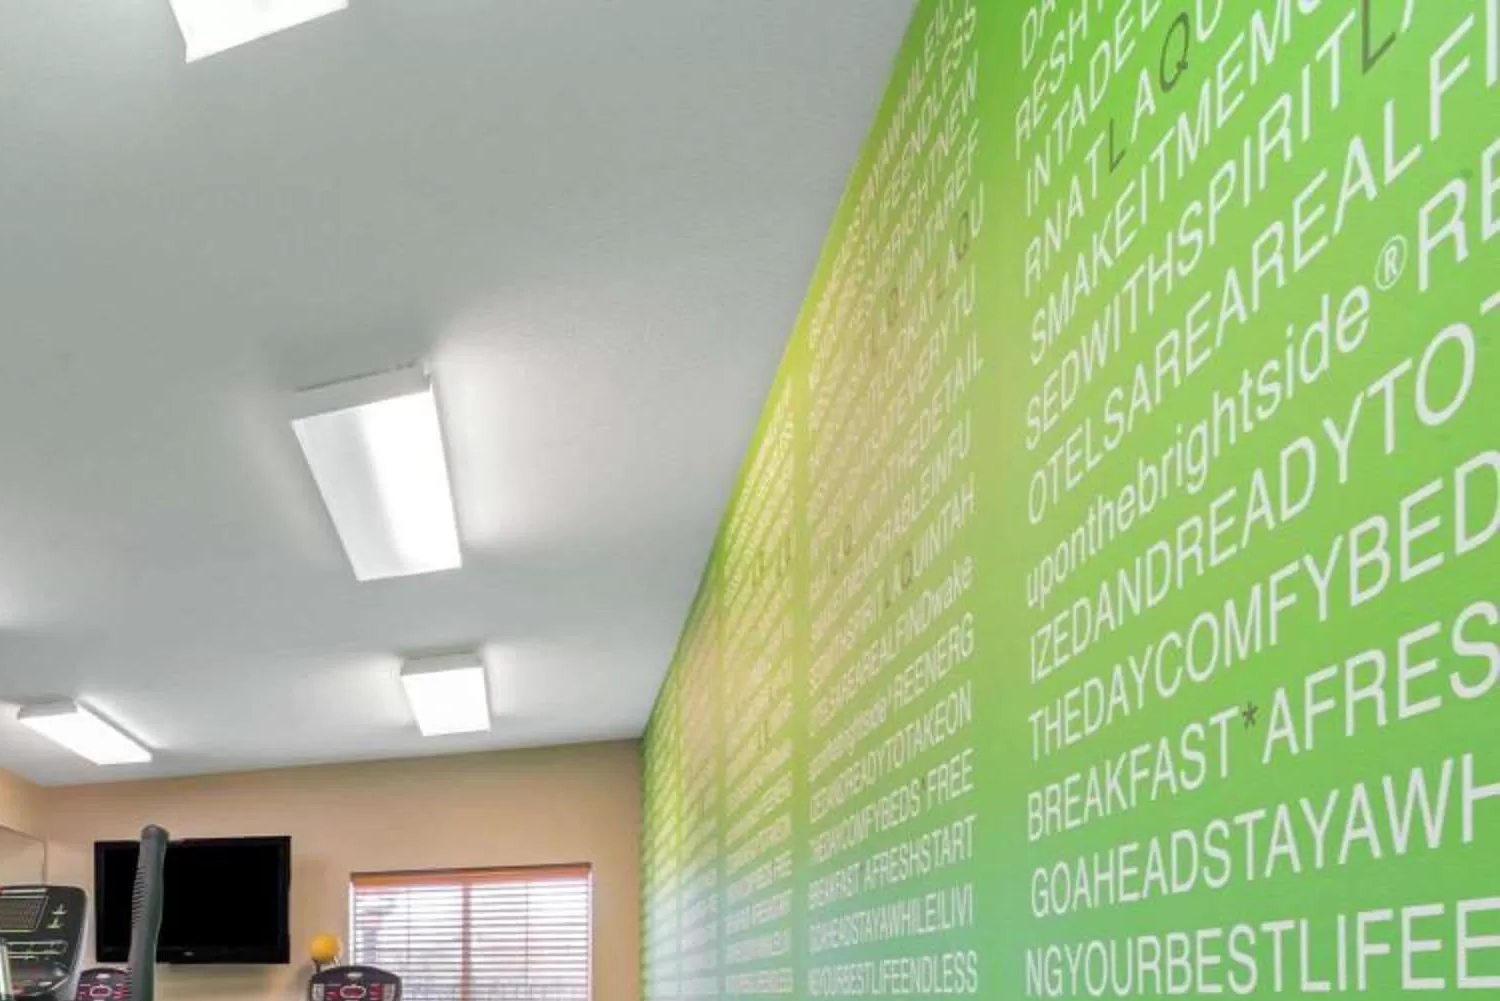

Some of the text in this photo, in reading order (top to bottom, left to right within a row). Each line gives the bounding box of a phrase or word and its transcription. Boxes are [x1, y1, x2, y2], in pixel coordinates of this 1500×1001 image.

[1015, 0, 1102, 160] RESH
[1031, 0, 1322, 366] SMAKEITMEM
[1030, 290, 1500, 684] IZEDANDREADYTO
